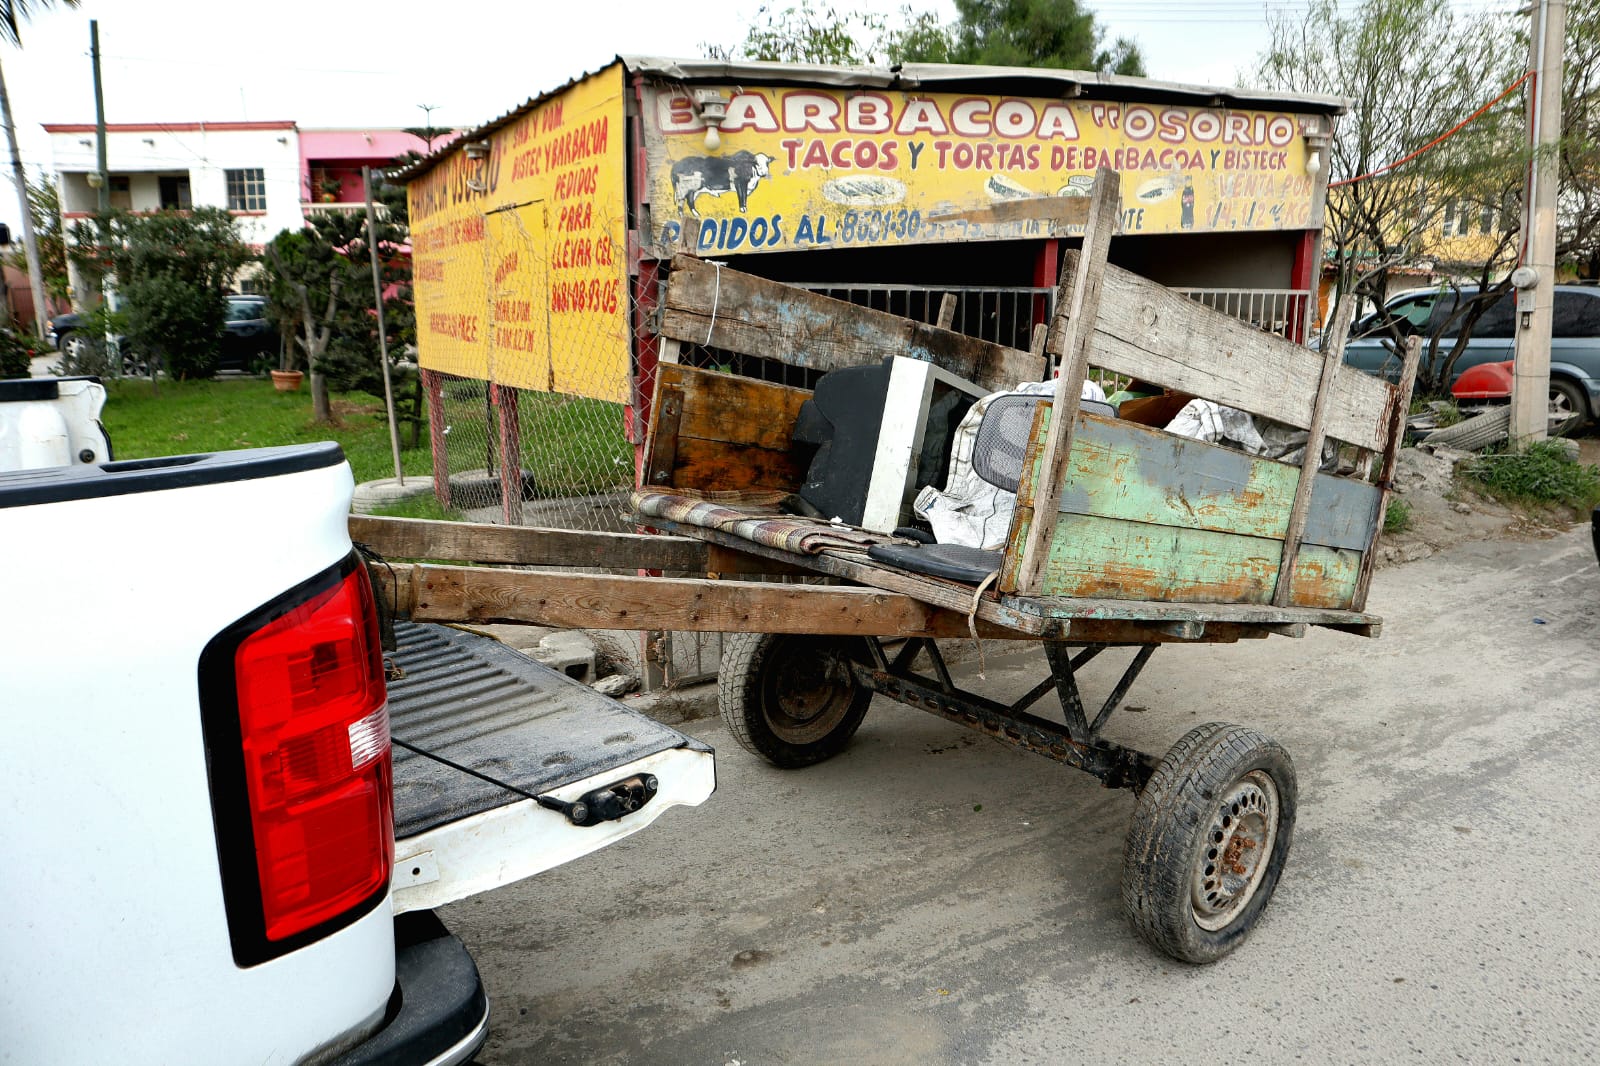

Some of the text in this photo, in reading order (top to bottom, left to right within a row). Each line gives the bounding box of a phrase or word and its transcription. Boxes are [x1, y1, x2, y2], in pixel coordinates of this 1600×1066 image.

[656, 89, 1079, 141] BARBACOA
[552, 115, 608, 170] BARBACOA
[783, 140, 899, 170] TACOS
[908, 141, 925, 170] Y
[934, 142, 1041, 171] TORTAS
[1083, 147, 1205, 171] BARBACOA
[1210, 149, 1221, 170] Y
[1223, 150, 1288, 171] BISTECK
[554, 164, 599, 201] PEDIDOS
[1279, 174, 1312, 198] POR
[558, 202, 592, 232] PARA
[660, 214, 782, 251] PDIDOS
[552, 238, 592, 270] LLEVAR
